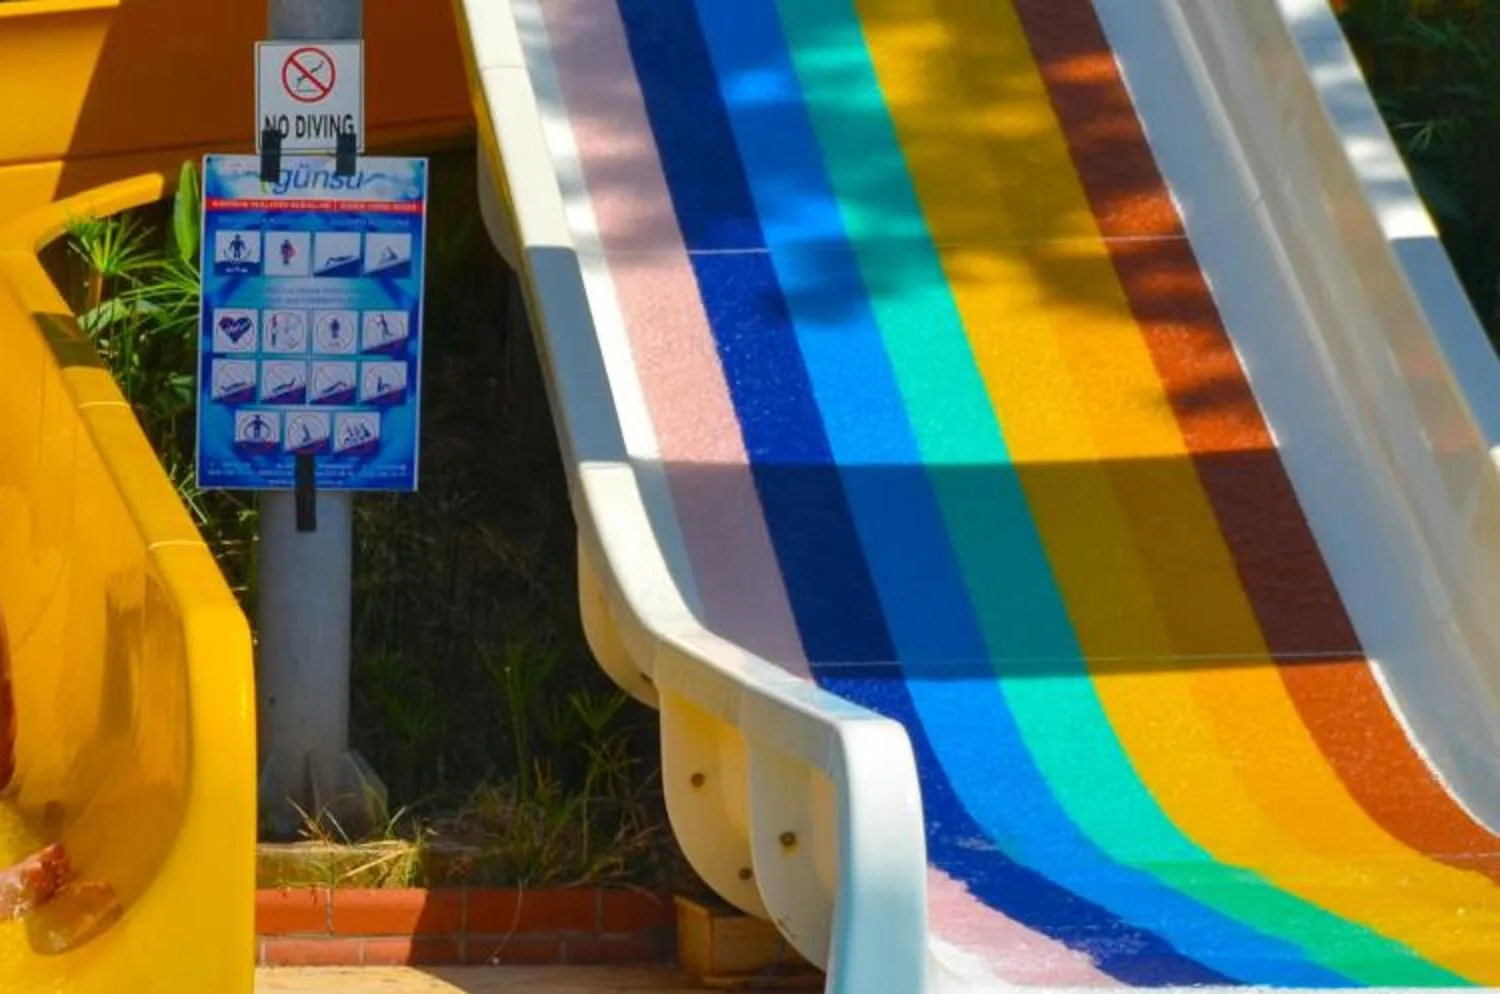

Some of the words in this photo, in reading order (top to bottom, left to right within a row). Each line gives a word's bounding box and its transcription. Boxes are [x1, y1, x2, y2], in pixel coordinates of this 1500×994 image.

[265, 114, 289, 139] NO
[295, 114, 354, 138] DIVING
[272, 164, 364, 194] günsu
